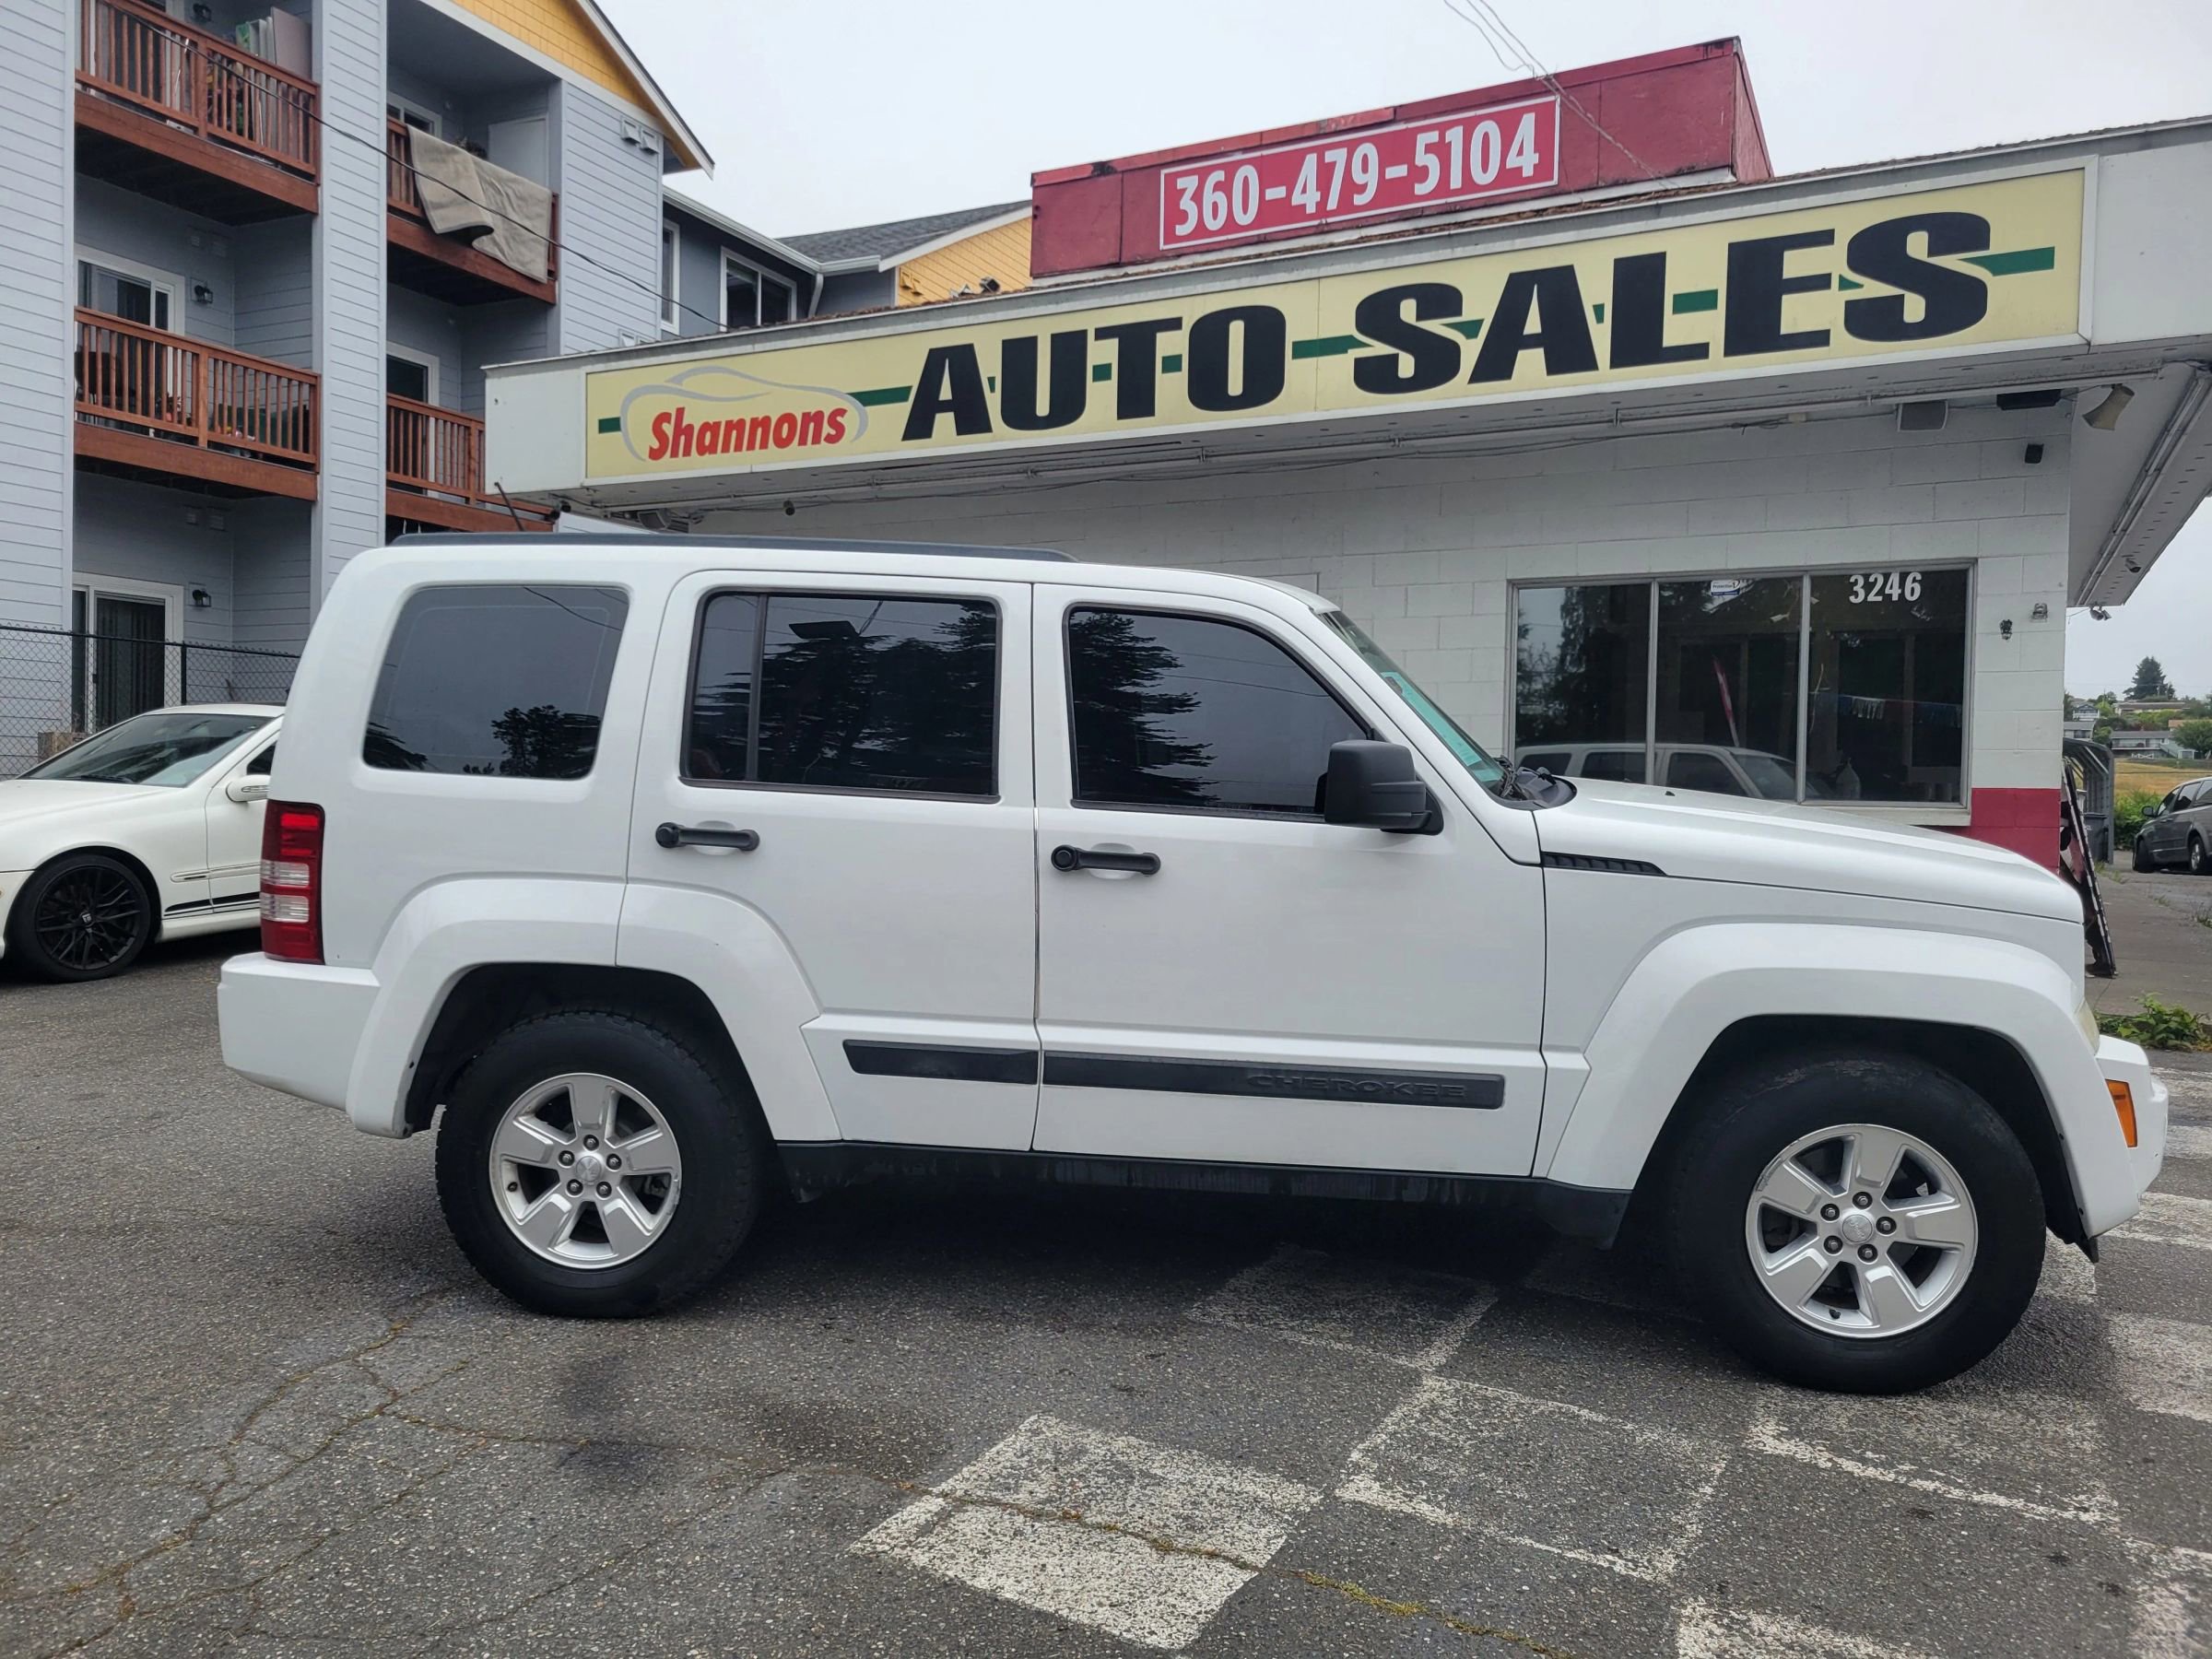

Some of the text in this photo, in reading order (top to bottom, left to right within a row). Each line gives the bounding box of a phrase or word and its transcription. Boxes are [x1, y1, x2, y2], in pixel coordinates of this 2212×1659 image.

[1175, 112, 1539, 236] 360-479-5104
[648, 211, 1991, 461] Shannons AUTO SALES
[1849, 571, 1923, 604] 3246
[1246, 1075, 1465, 1098] CHEROKEE
